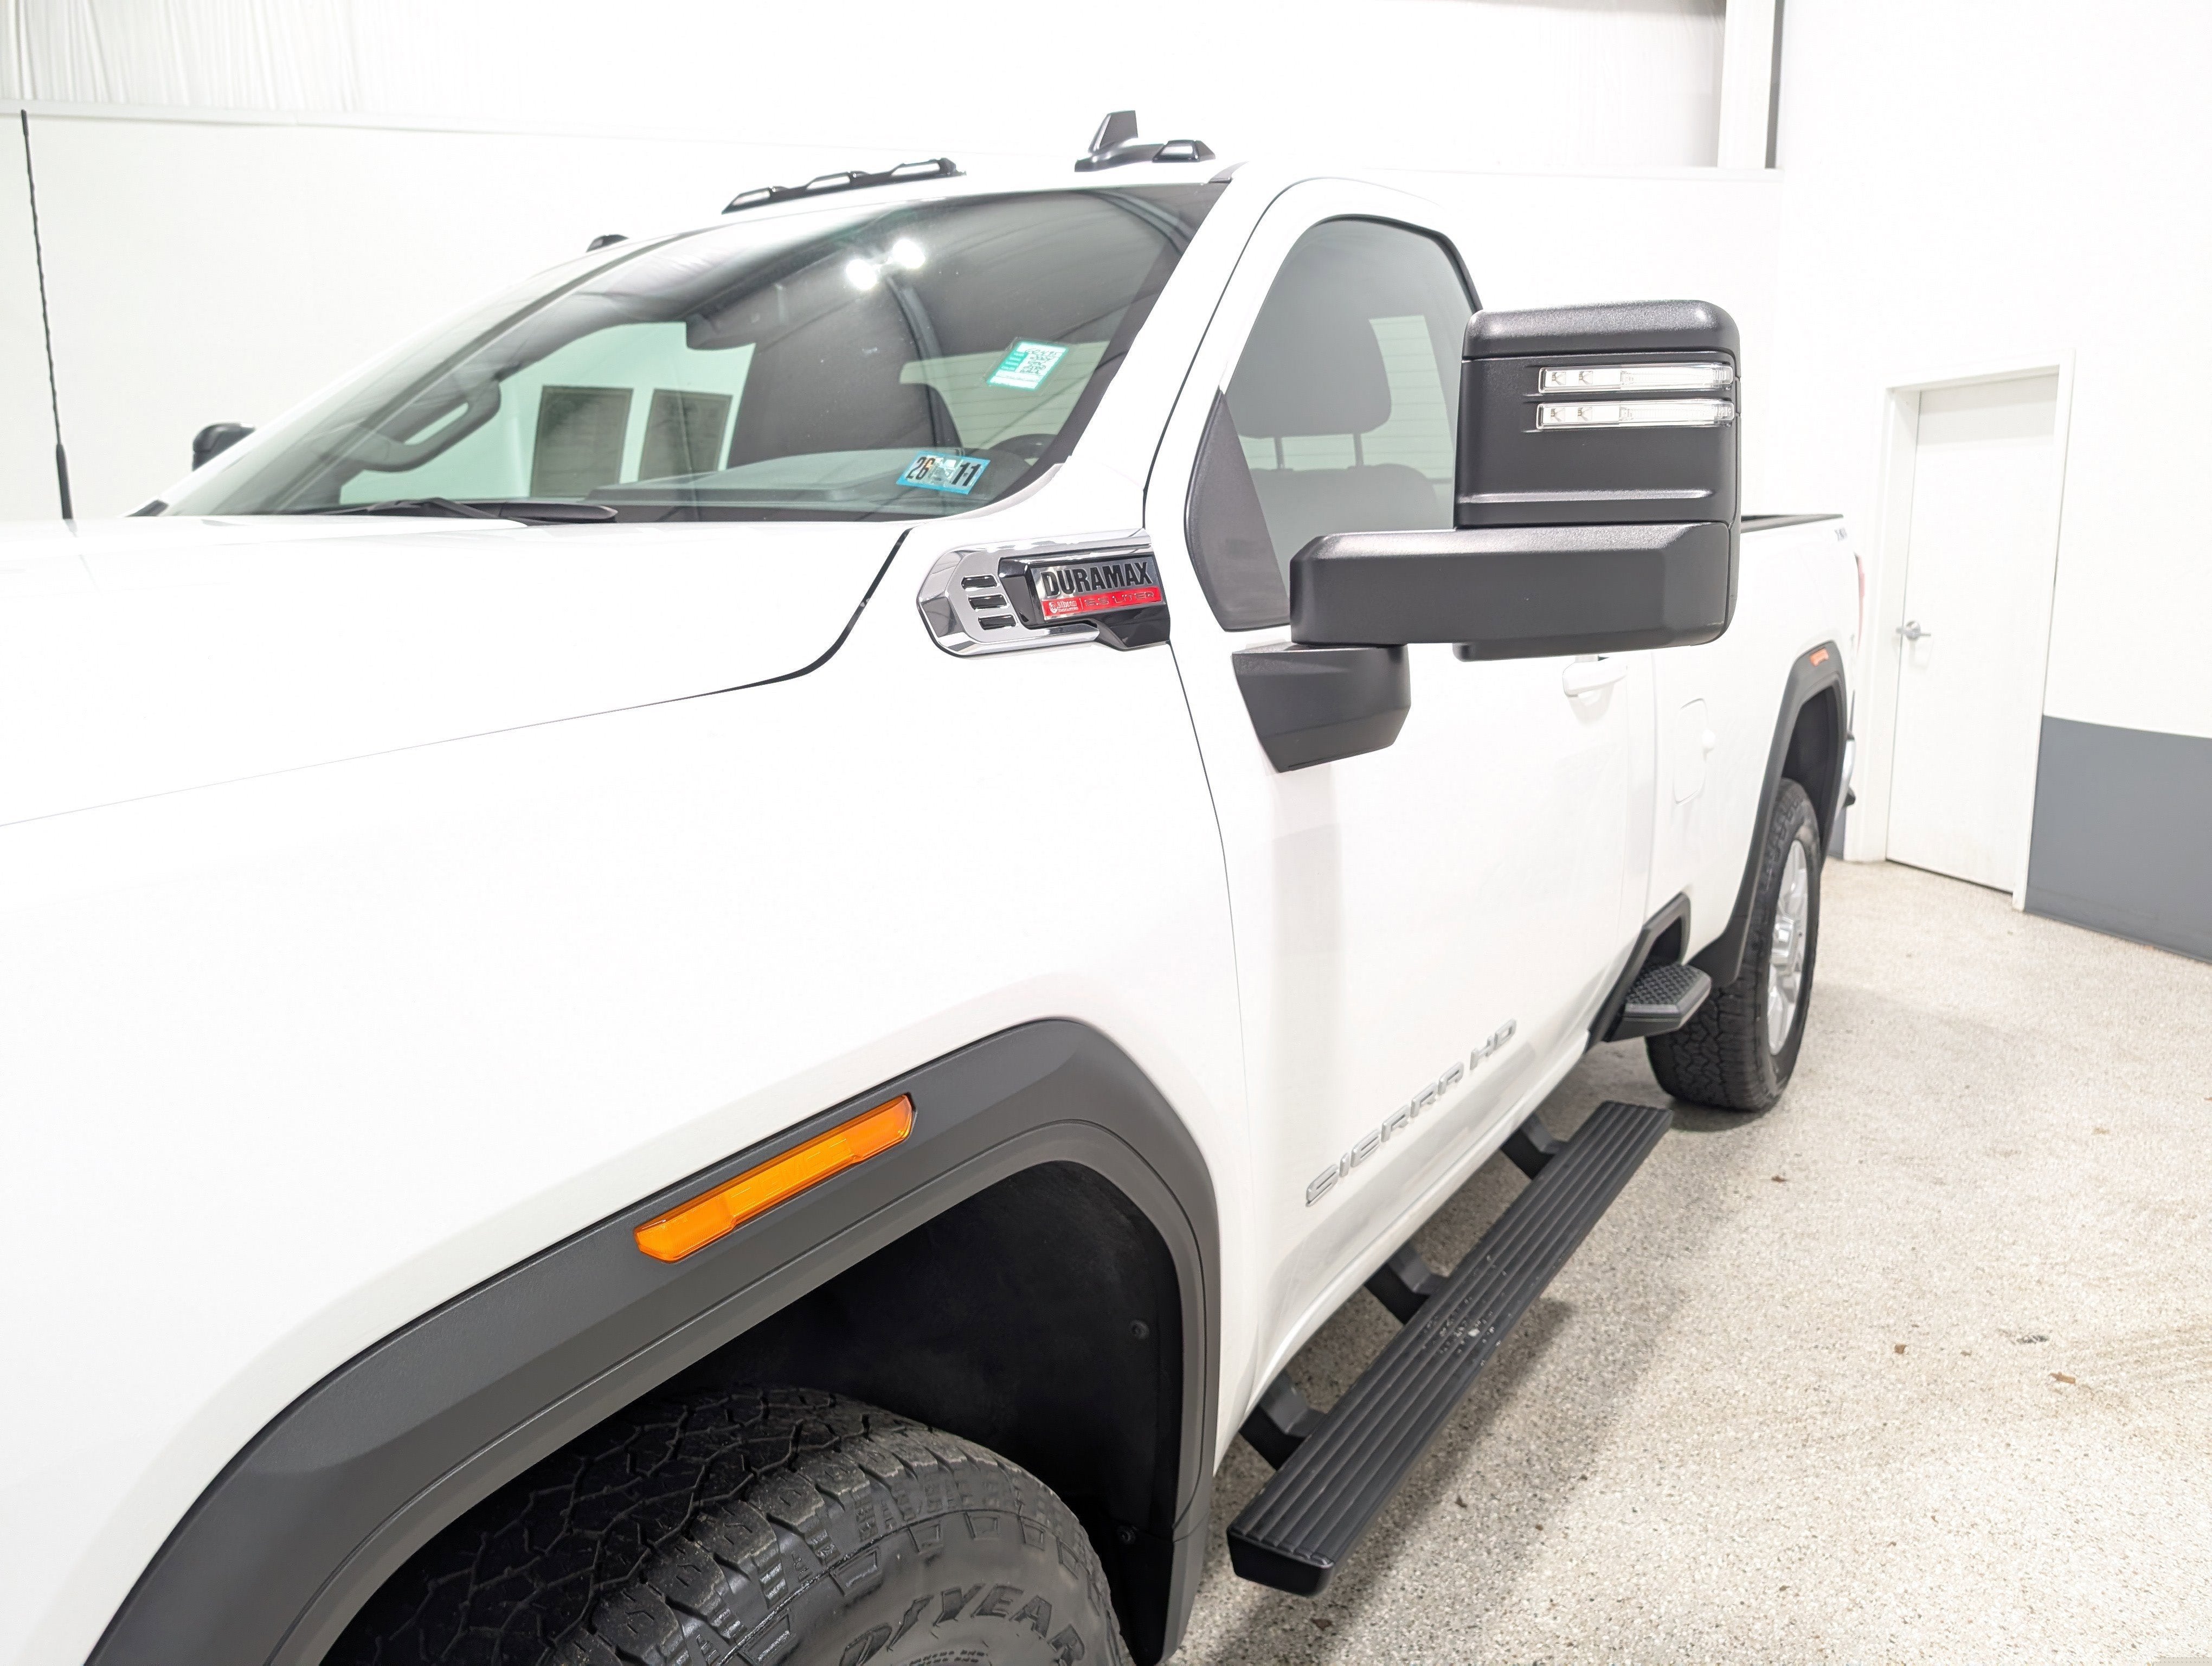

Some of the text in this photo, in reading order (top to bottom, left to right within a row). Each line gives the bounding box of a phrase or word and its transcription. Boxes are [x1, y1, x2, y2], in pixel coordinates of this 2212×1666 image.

[905, 457, 936, 480] 26
[951, 462, 982, 486] 11
[1041, 561, 1153, 597] DURAMAX
[1113, 591, 1155, 604] LITER
[1305, 1018, 1517, 1208] SIERRA HD
